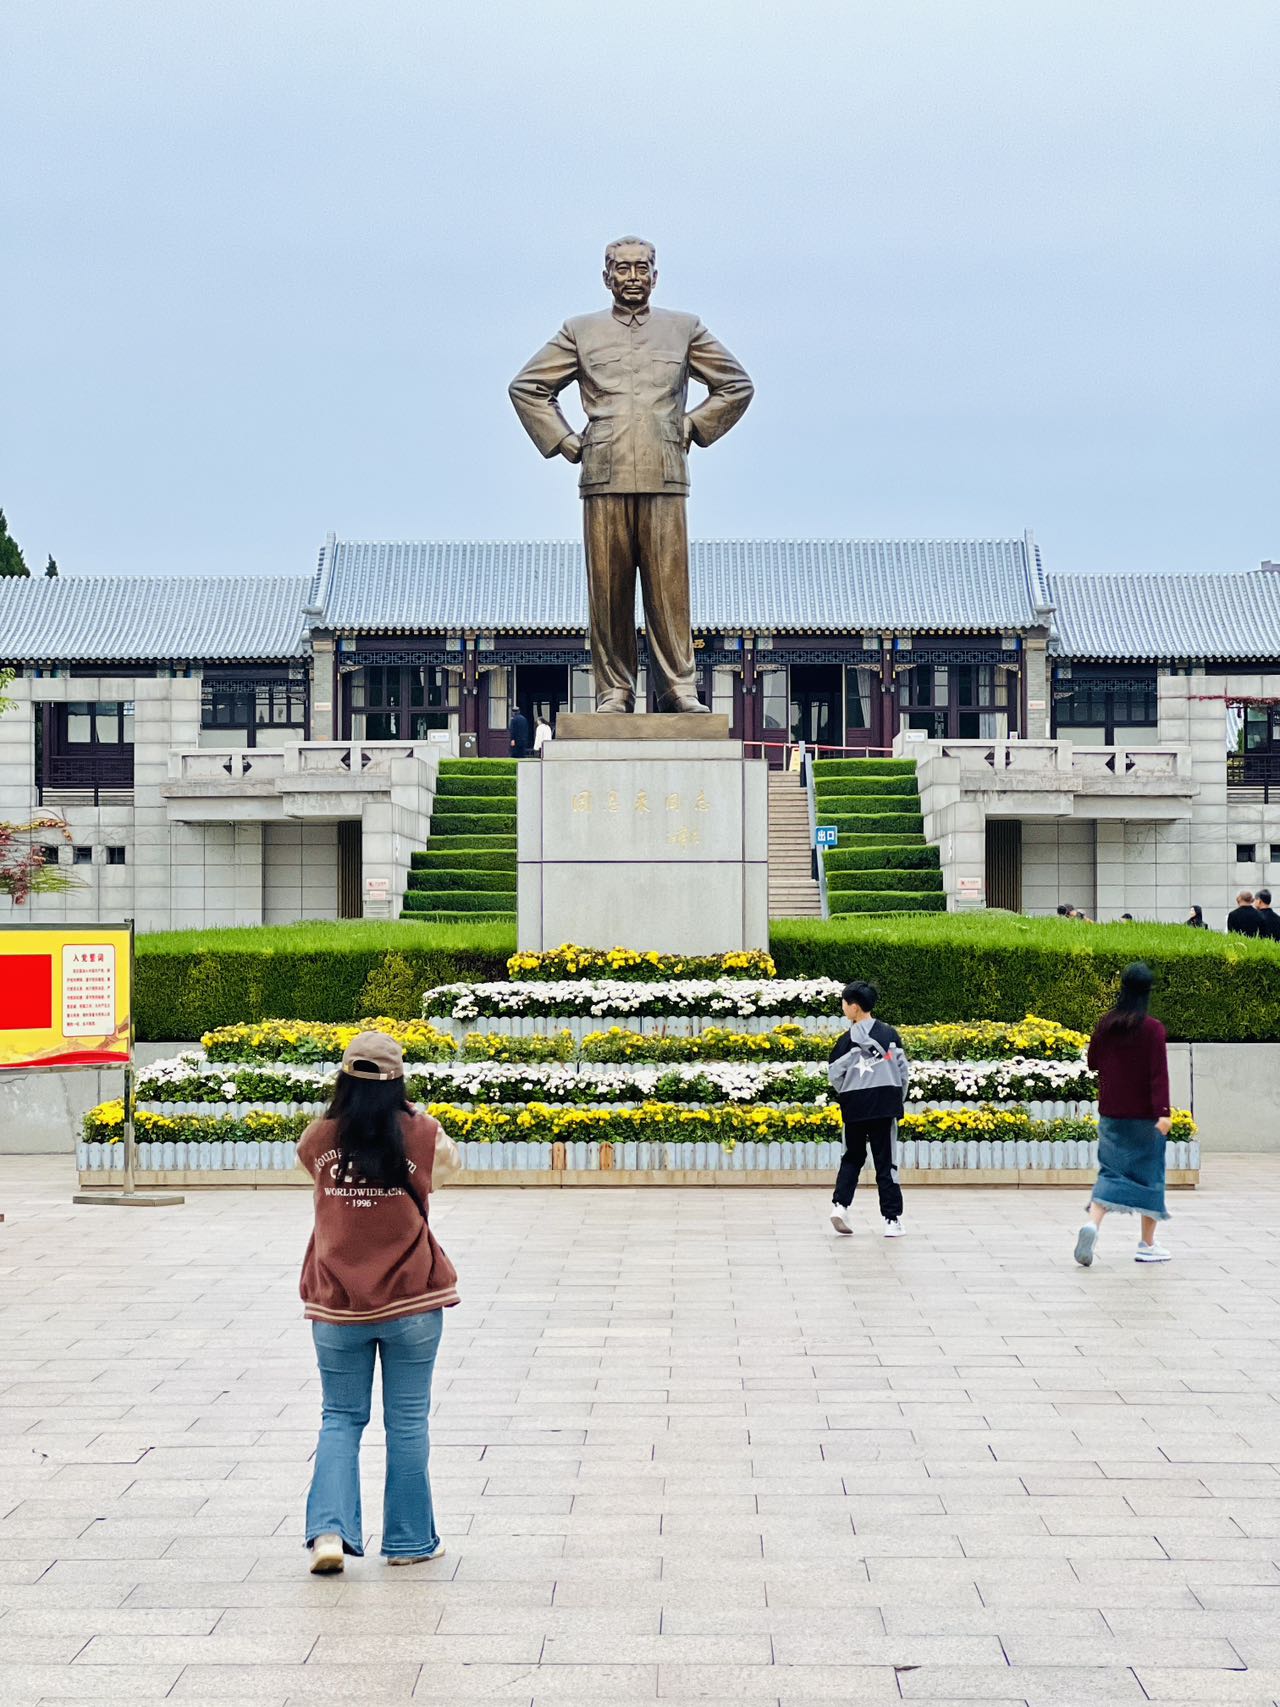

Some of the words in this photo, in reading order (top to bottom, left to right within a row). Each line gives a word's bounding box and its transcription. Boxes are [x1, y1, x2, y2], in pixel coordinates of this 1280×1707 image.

[817, 829, 835, 842] 出口
[72, 953, 105, 962] 入党誓词
[352, 1199, 372, 1208] 1996
